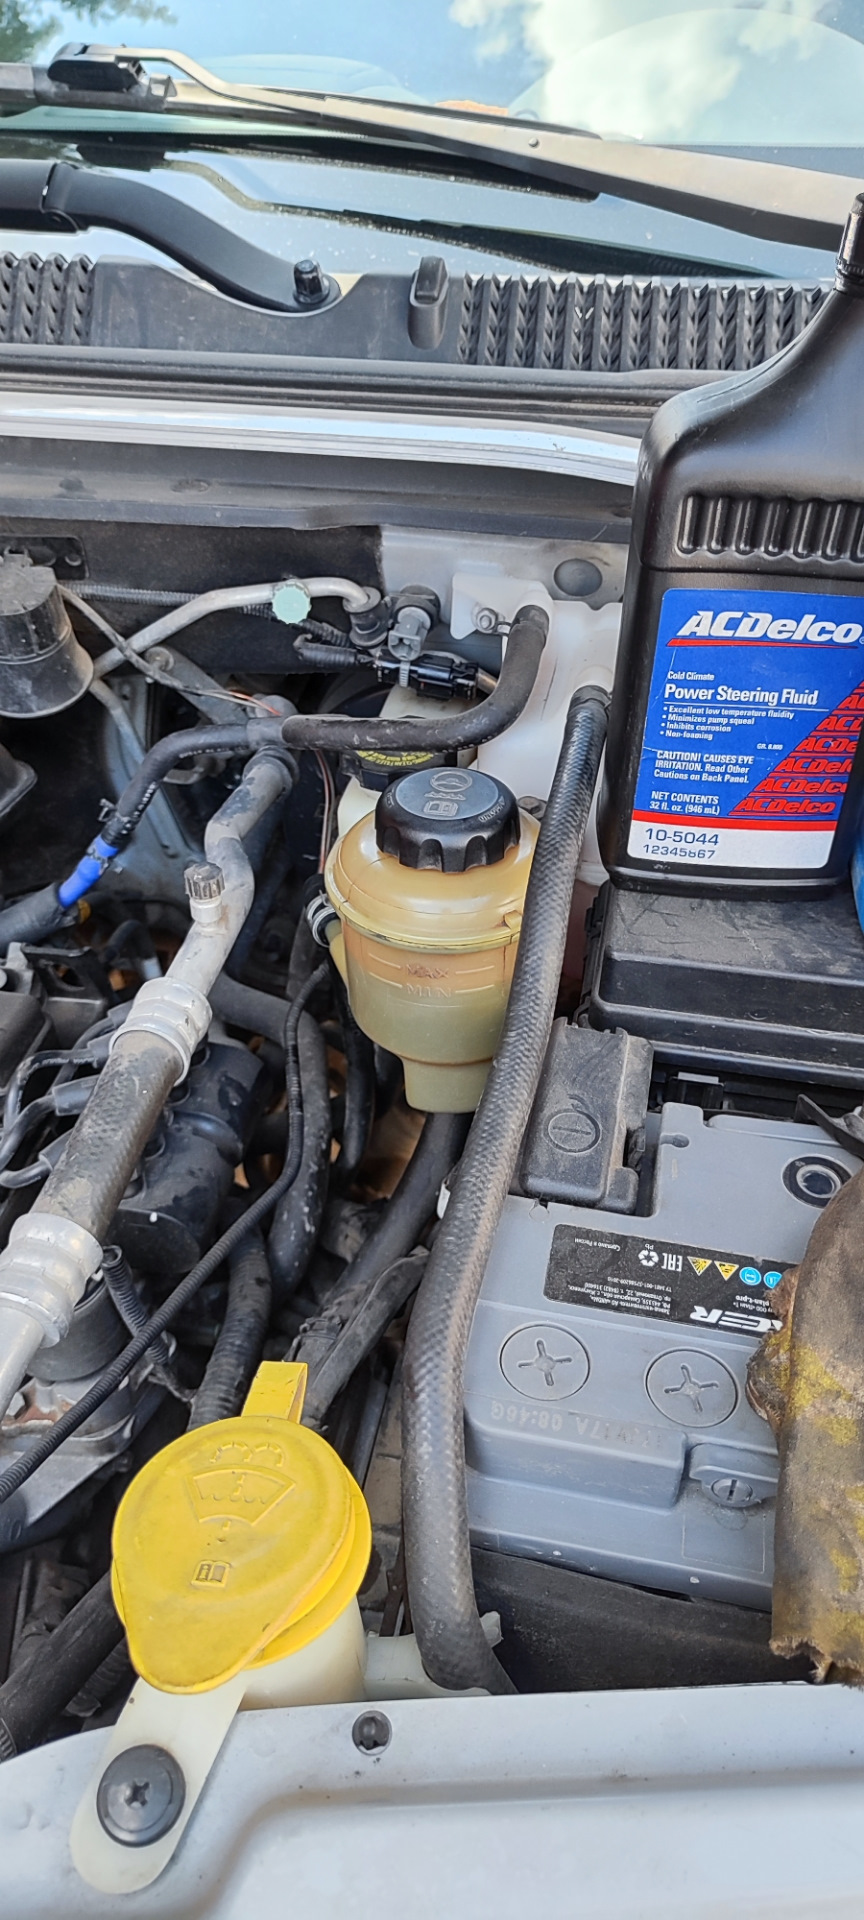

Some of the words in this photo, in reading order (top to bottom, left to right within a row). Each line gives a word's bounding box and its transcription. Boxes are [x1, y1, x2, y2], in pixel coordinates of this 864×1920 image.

[676, 610, 863, 644] ACDelco
[668, 671, 685, 680] Cold
[686, 672, 715, 681] Climate
[664, 684, 715, 700] Power
[716, 685, 779, 705] Steering
[781, 689, 818, 706] Fluid
[668, 714, 707, 723] Minimizes
[707, 716, 728, 725] pump
[729, 717, 755, 726] squeal
[669, 706, 705, 715] Excellent
[706, 707, 720, 715] low
[721, 708, 767, 718] temperature
[768, 710, 795, 720] fluidity
[667, 722, 695, 730] Inhibits
[696, 724, 732, 732] corrosion
[665, 730, 713, 740] Non-foaming
[657, 750, 701, 762] CAUTION!
[703, 754, 737, 764] CAUSES
[738, 756, 754, 764] EYE
[655, 760, 703, 771] IRRITATION.
[705, 764, 725, 773] Read
[727, 764, 749, 774] Other
[654, 769, 689, 780] Cautions
[702, 773, 723, 782] Back
[724, 775, 750, 784] Panel.
[651, 791, 670, 801] NET
[671, 793, 719, 804] CONTENTS
[649, 801, 660, 810] 32
[661, 802, 670, 810] fl.
[685, 804, 703, 814] (946
[704, 805, 720, 815] mL)
[733, 798, 836, 813] ACDelco
[645, 828, 719, 846] 10-5044
[406, 964, 449, 979] MAX
[406, 983, 452, 998] MIN
[661, 1252, 683, 1272] EAC
